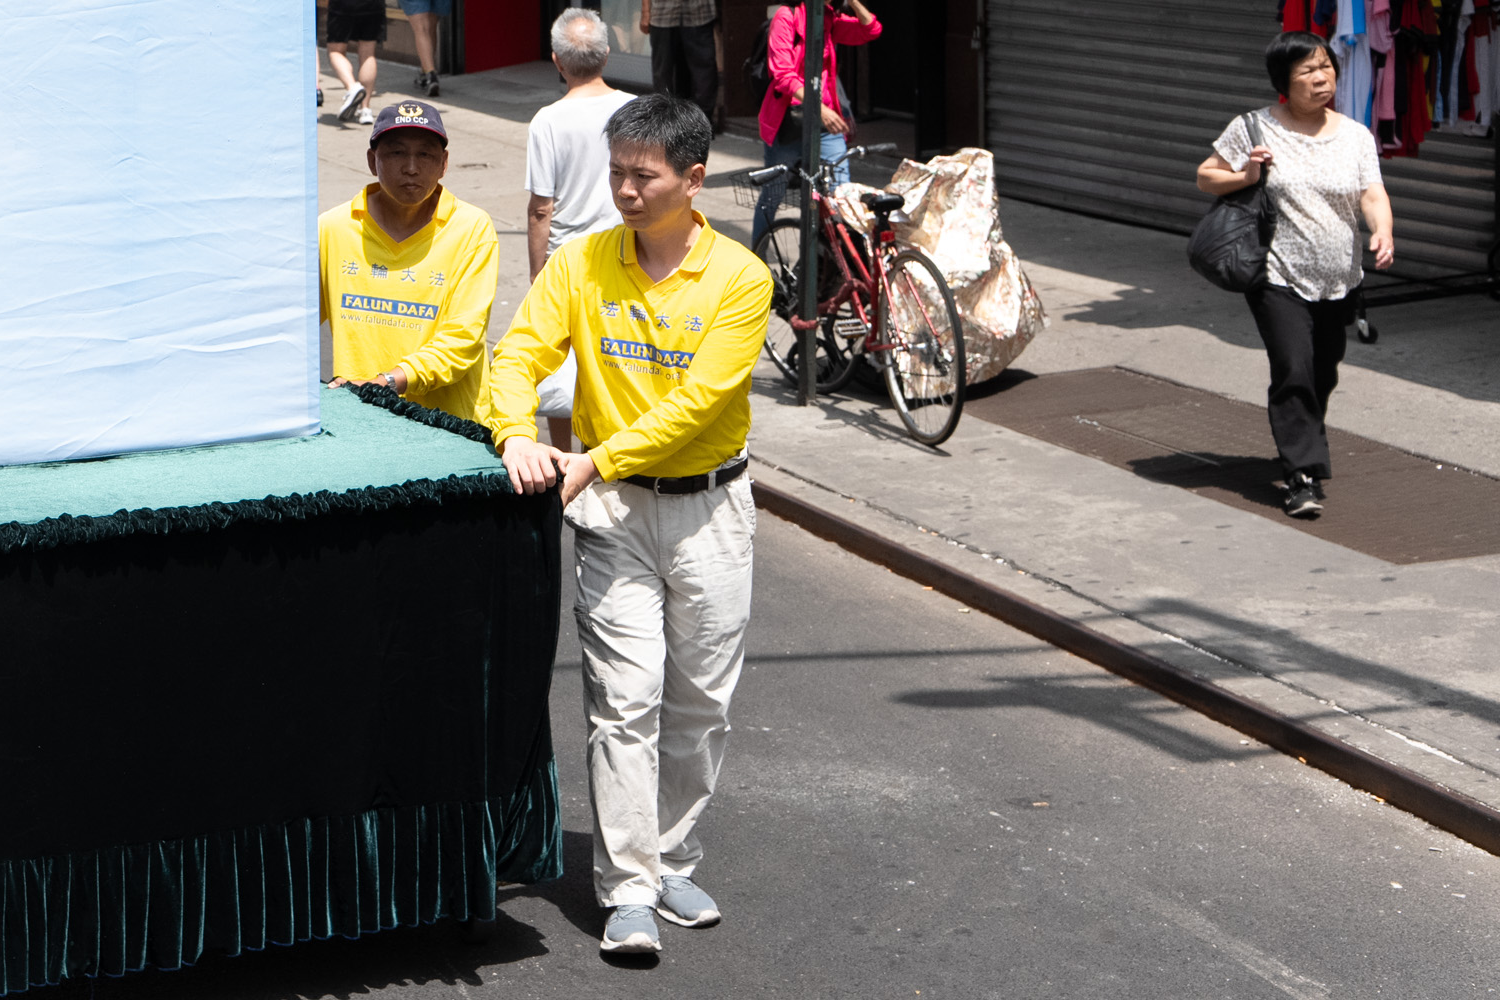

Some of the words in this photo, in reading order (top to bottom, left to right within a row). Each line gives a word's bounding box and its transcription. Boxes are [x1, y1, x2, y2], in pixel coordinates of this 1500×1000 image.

[395, 116, 412, 124] END
[413, 117, 429, 125] CCP
[341, 259, 446, 287] 法輪大法
[345, 295, 393, 313] FALUN
[397, 303, 435, 319] DAFA
[600, 298, 703, 332] 法輪大法
[340, 312, 423, 332] www.falundafa.org
[603, 340, 653, 359] FALUN
[656, 351, 691, 367] DAFA
